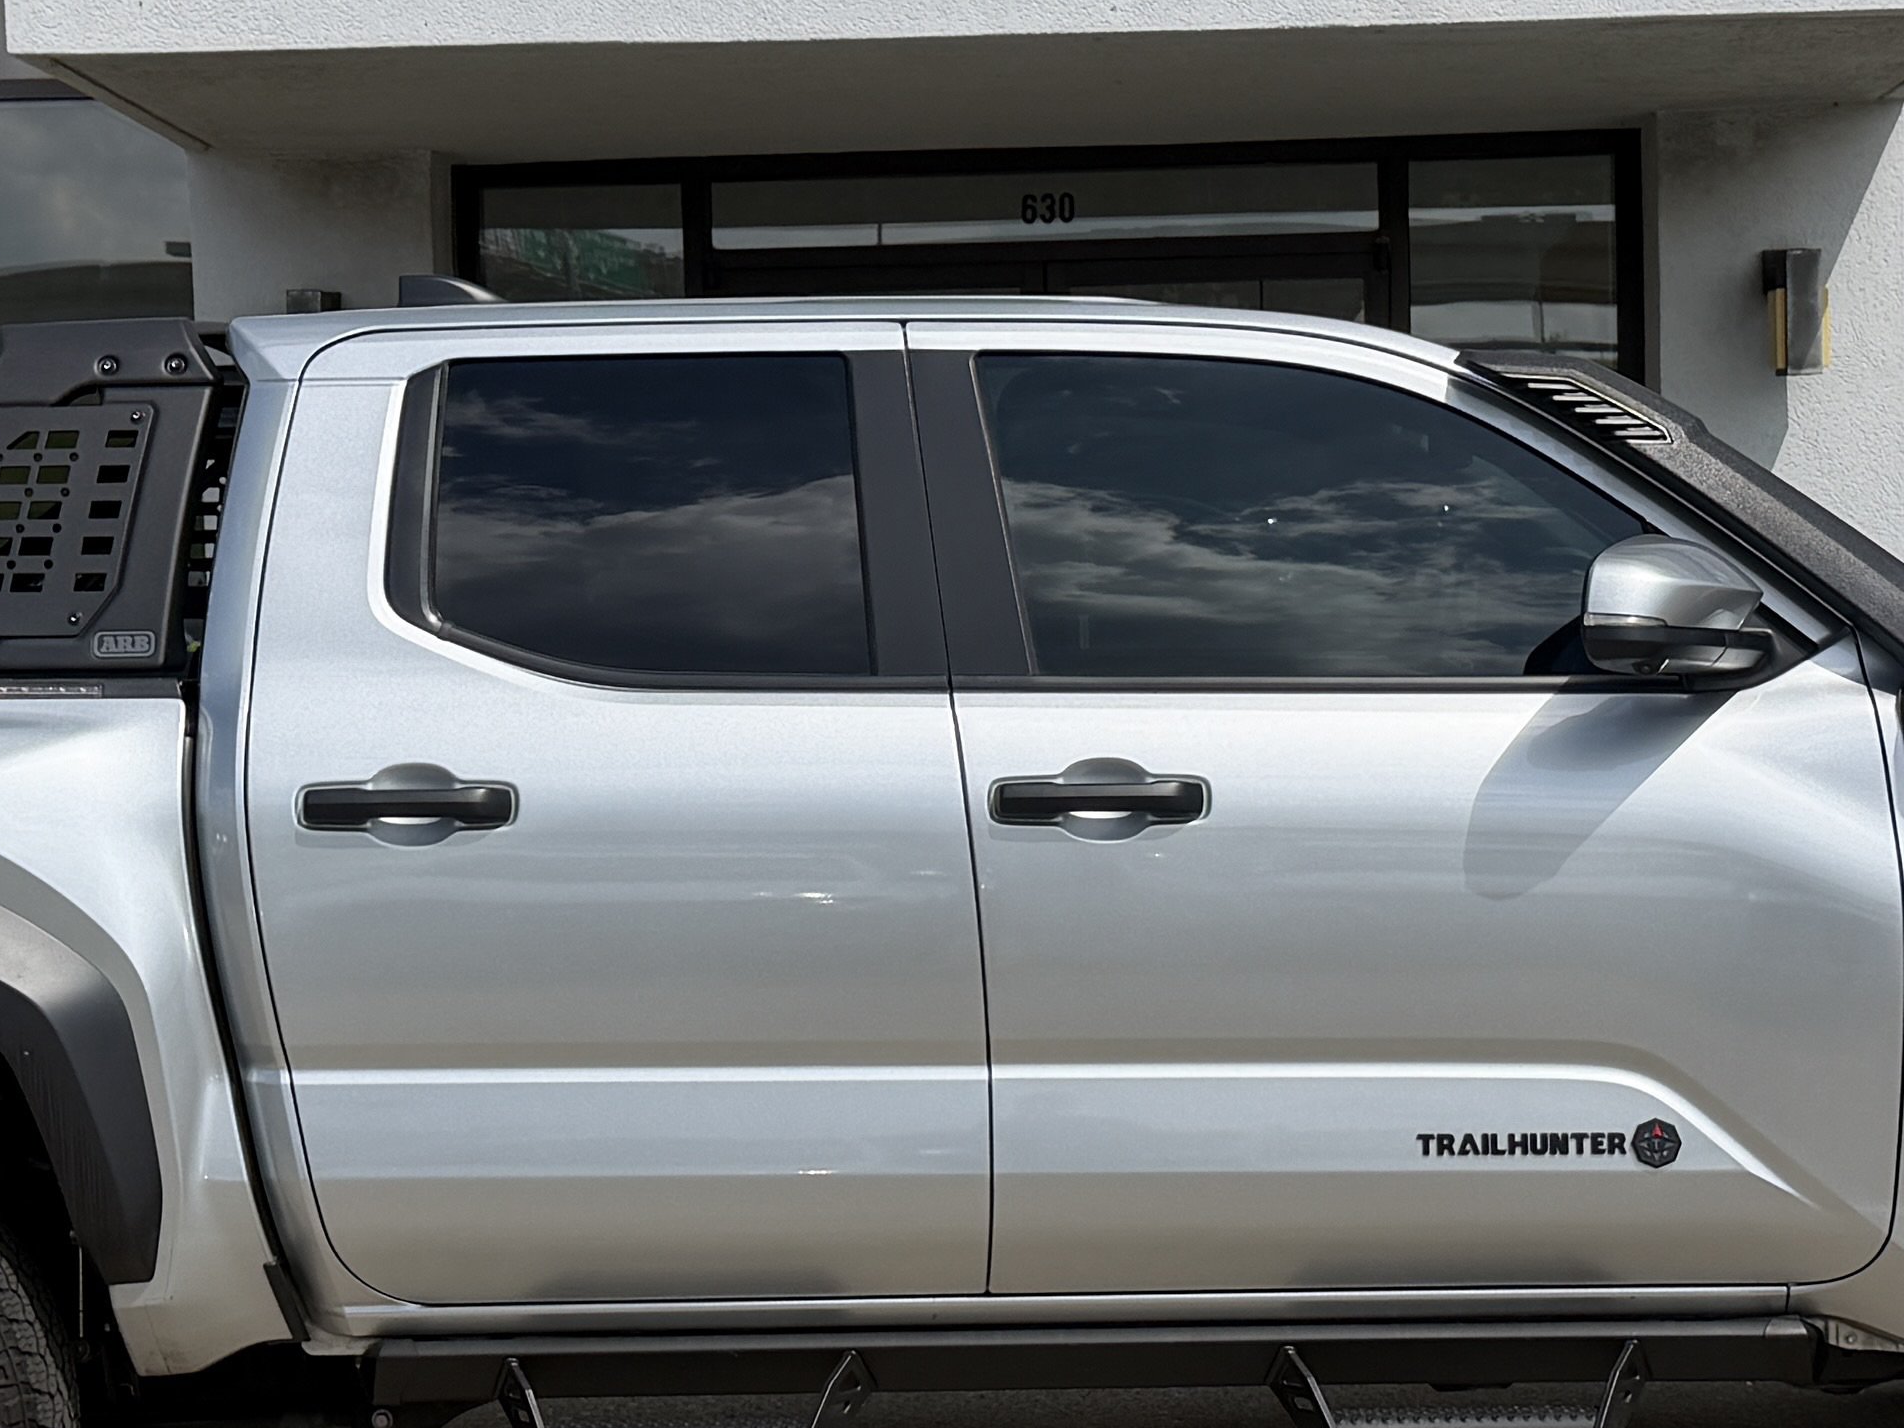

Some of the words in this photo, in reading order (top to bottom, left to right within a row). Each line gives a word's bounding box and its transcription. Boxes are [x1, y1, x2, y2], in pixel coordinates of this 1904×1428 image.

[1021, 192, 1076, 224] 630
[99, 635, 149, 654] ARB
[1416, 1132, 1627, 1157] TRAILHUNTER
